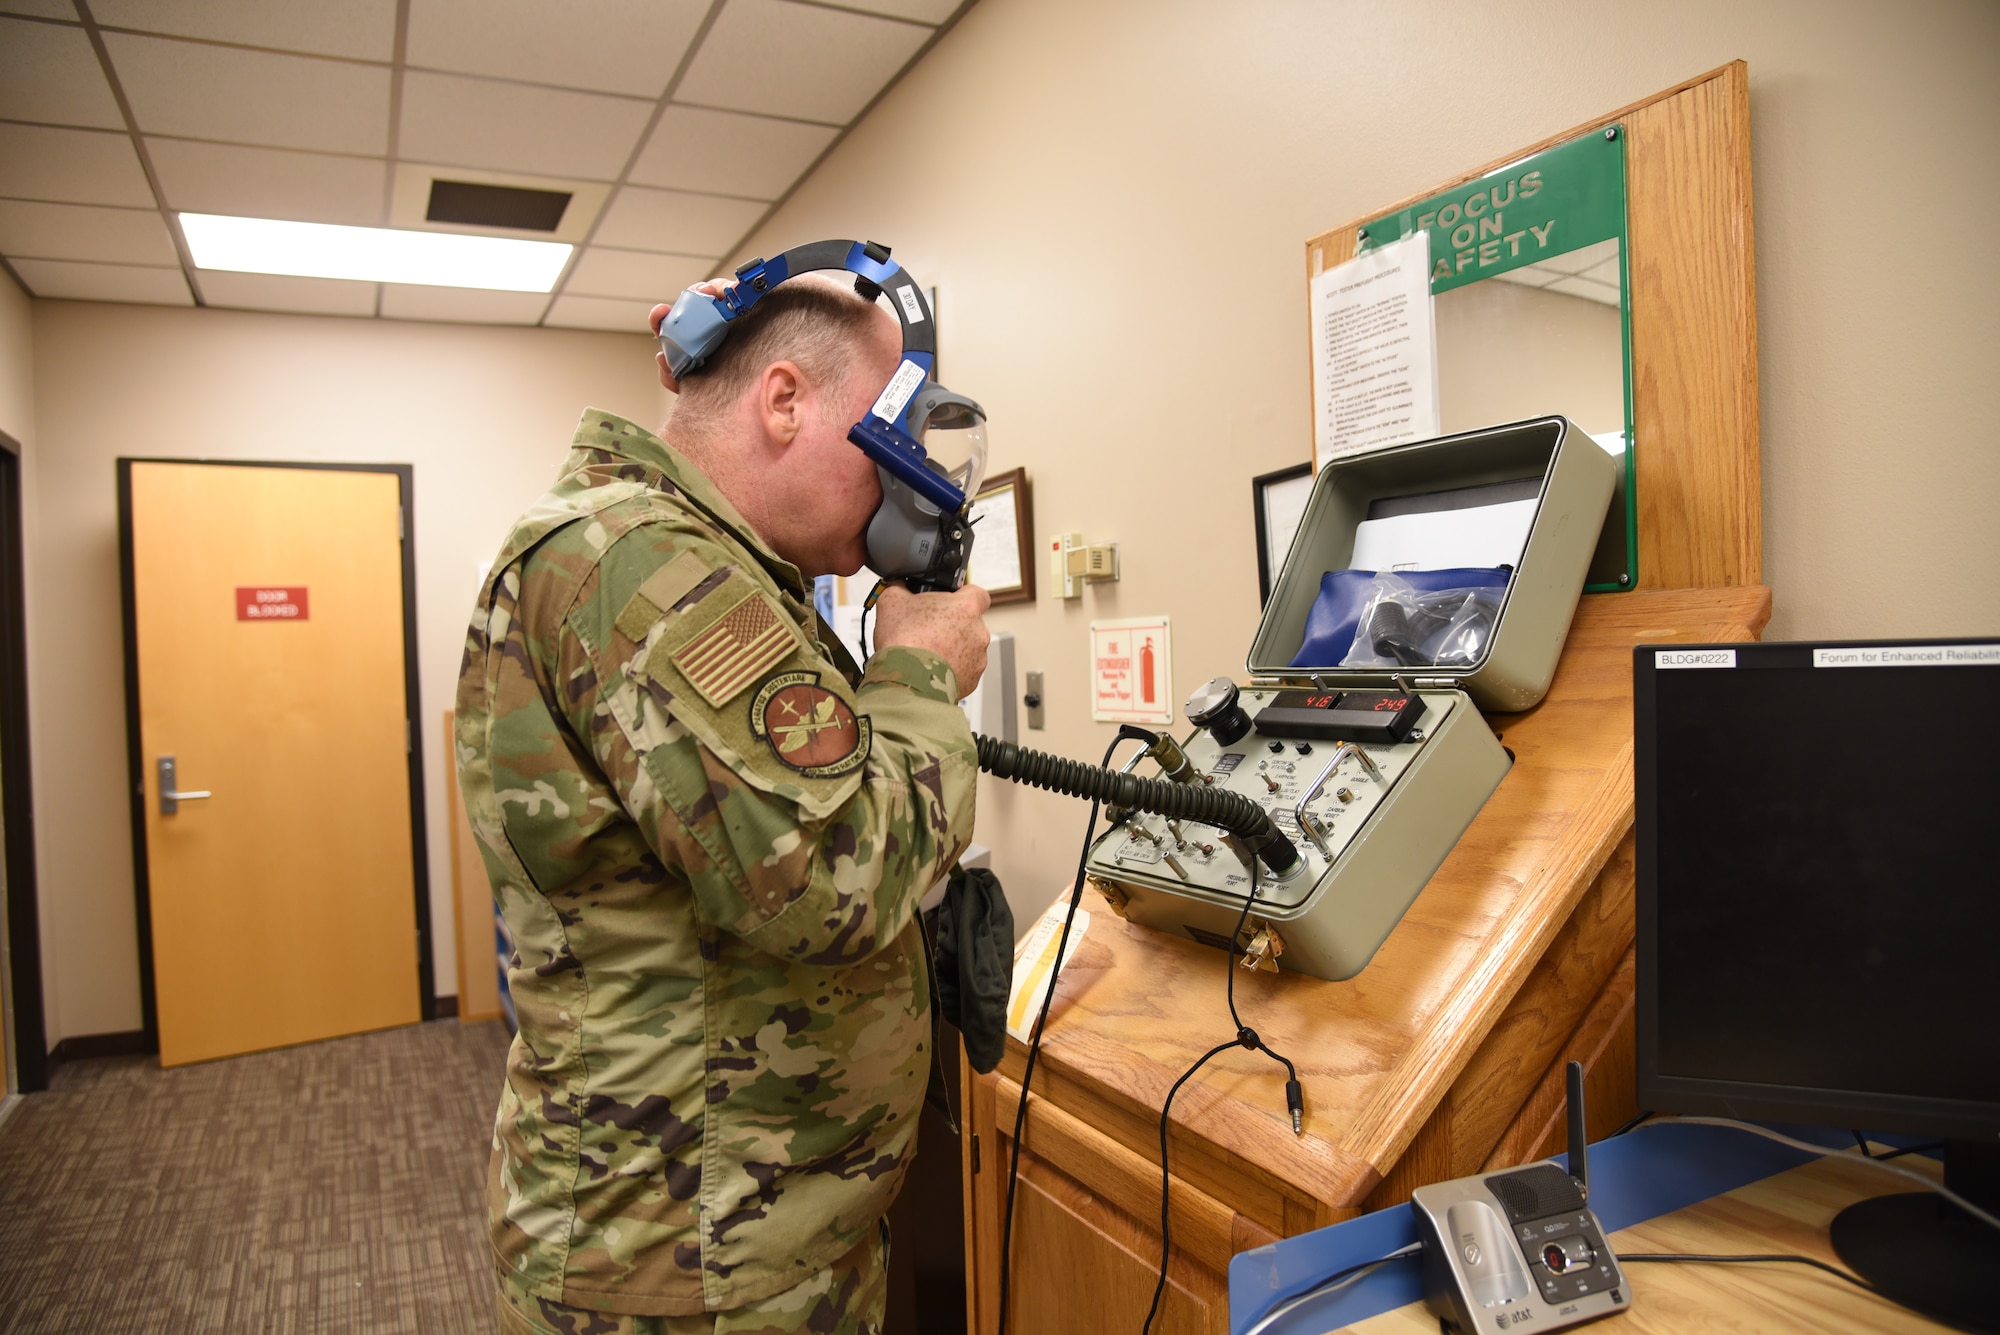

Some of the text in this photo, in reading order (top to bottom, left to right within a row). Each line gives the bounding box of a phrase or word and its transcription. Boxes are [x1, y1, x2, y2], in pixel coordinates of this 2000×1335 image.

[1416, 170, 1543, 232] FOCUS
[1450, 211, 1503, 249] ON
[1430, 219, 1556, 283] AFETY
[256, 589, 288, 603] DOOR
[1661, 652, 1729, 665] BLDG#0222
[1820, 652, 1858, 663] Forum
[1861, 651, 1877, 662] for
[1881, 650, 1942, 662] Enhanced
